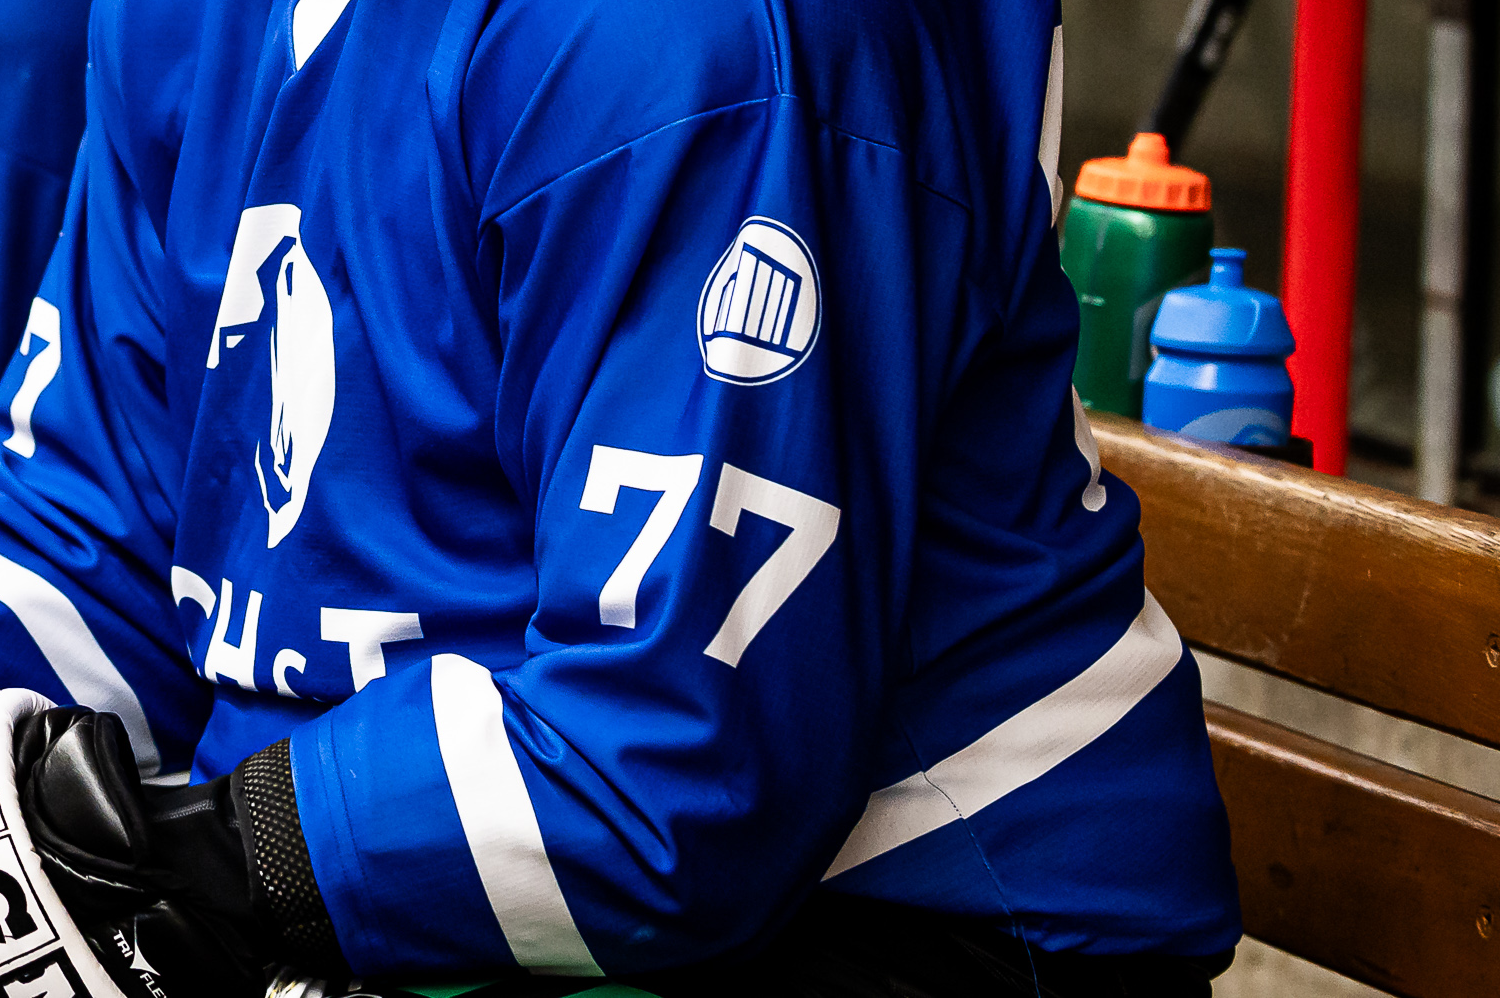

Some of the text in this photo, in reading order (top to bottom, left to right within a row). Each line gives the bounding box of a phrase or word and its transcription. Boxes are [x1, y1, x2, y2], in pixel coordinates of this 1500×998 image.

[579, 444, 842, 669] 77
[113, 930, 168, 998] TRI FLE
